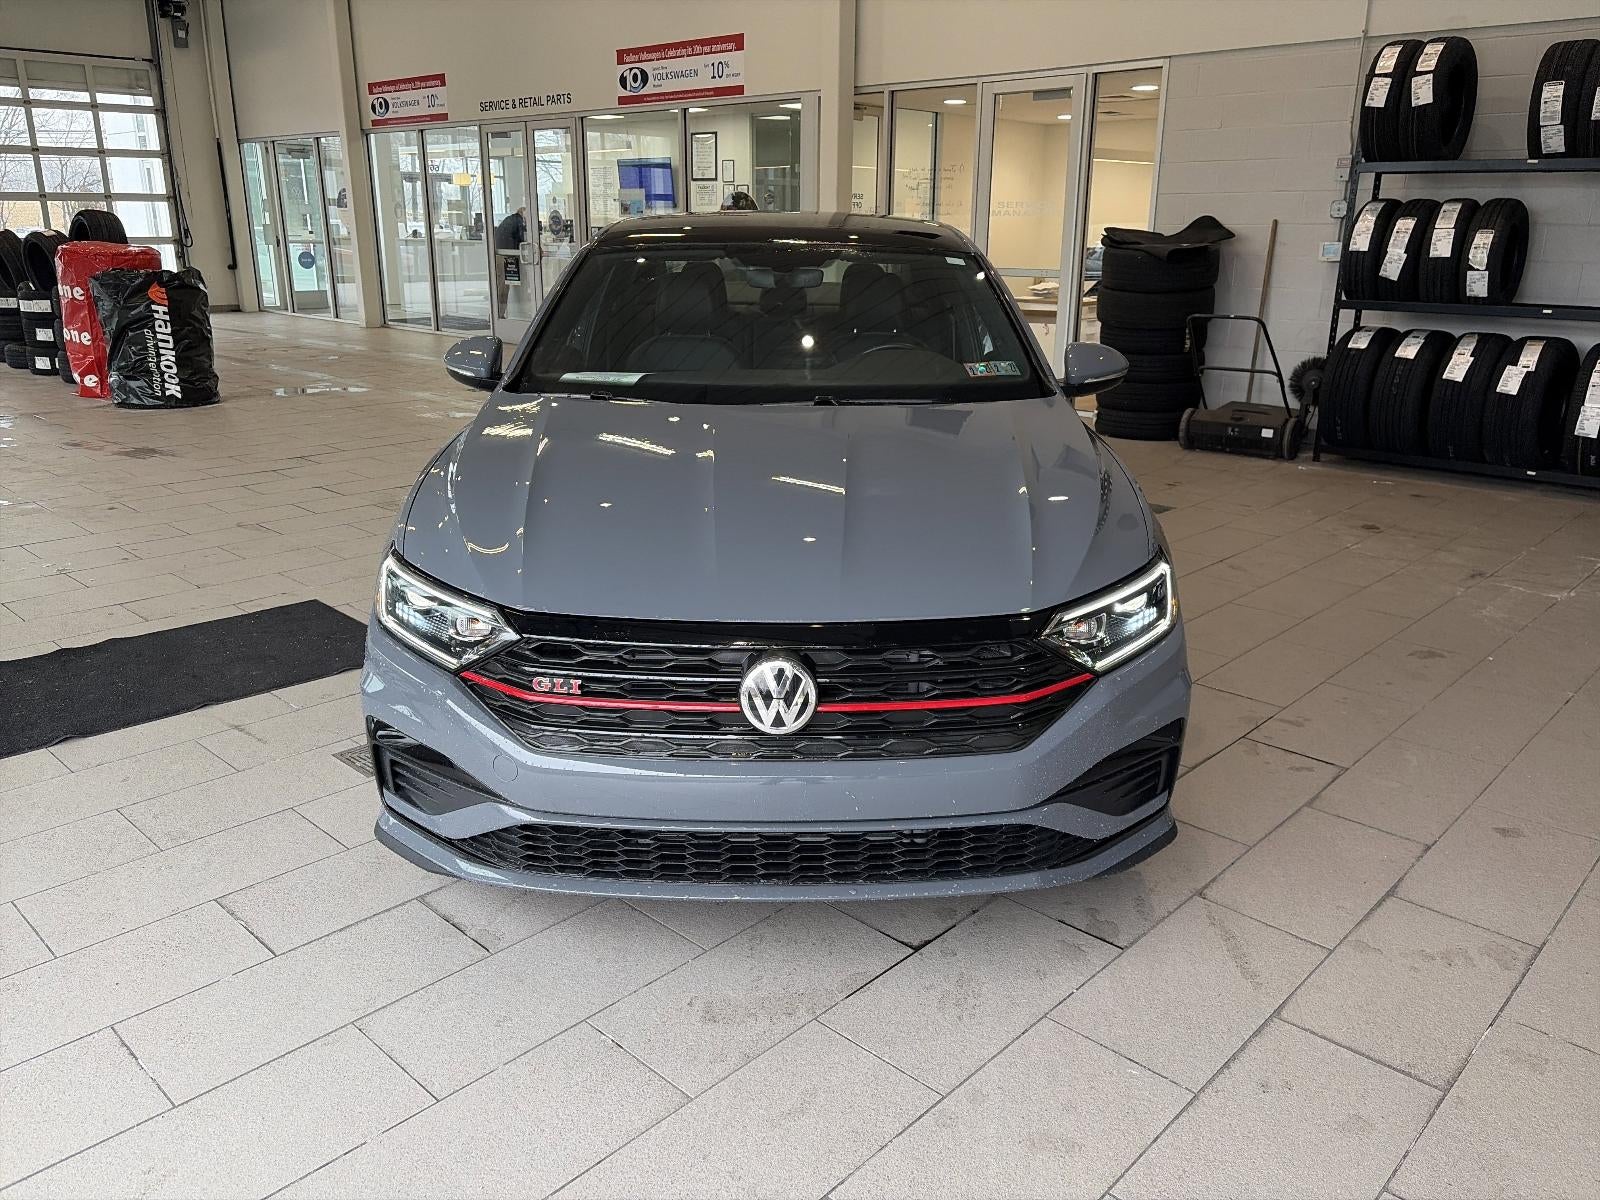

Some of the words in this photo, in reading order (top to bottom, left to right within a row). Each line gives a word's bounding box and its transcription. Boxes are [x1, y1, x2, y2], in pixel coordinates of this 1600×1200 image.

[652, 68, 699, 82] VOLKSWAGEN
[479, 99, 510, 112] SERVICE
[511, 98, 517, 109] &
[518, 96, 544, 109] RETAIL
[546, 92, 572, 106] PARTS
[143, 328, 157, 364] driving
[151, 304, 182, 399] Hankook
[531, 676, 582, 695] GLI
